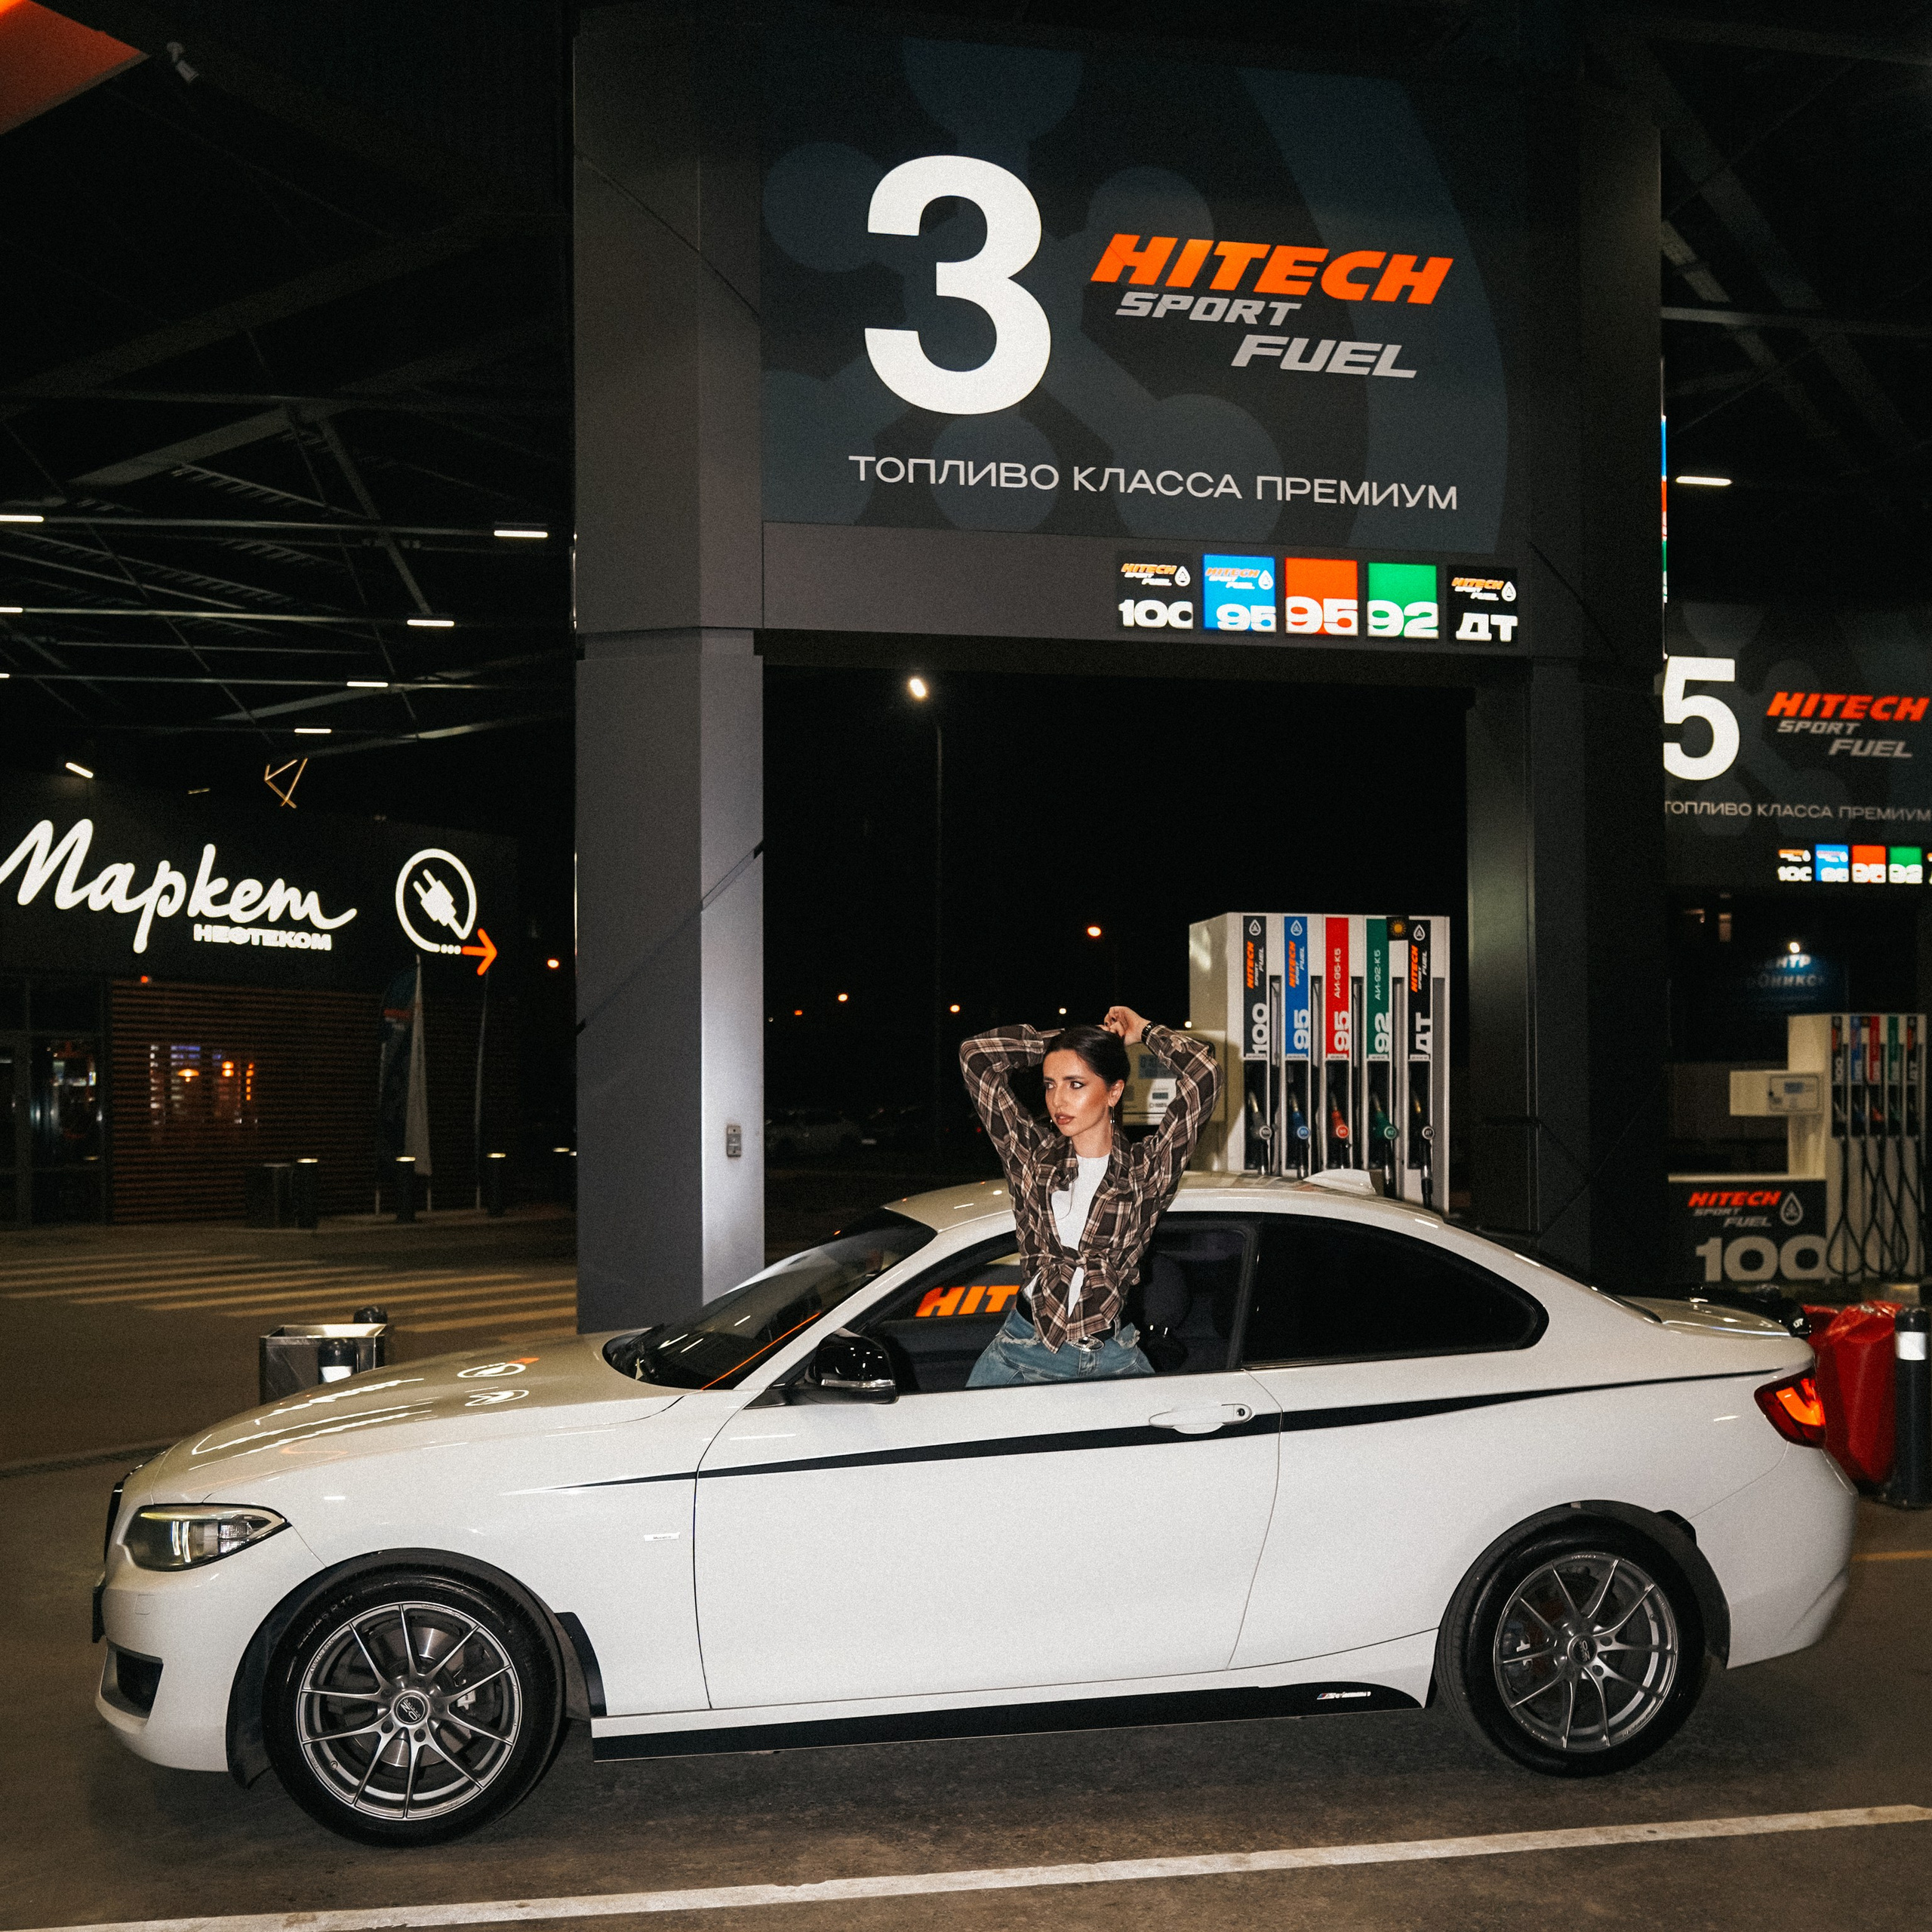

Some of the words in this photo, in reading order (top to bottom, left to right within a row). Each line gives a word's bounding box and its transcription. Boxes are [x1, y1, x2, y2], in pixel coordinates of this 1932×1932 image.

[865, 155, 1051, 415] 3
[1091, 233, 1454, 304] HITECH
[1115, 291, 1302, 326] SPORT
[1231, 334, 1417, 378] FUEL
[848, 455, 1060, 491] ТОПЛИВО
[1072, 466, 1243, 499] КЛАССА
[1257, 475, 1458, 510] ПРЕМИУМ
[1121, 563, 1177, 574] HITECH
[1204, 567, 1260, 577] HITECH
[1451, 577, 1504, 589] HITECH
[1118, 599, 1194, 629] 100
[1216, 603, 1277, 632] 95
[1285, 596, 1358, 635] 95
[1367, 600, 1439, 639] 92
[1455, 612, 1518, 642] ДТ
[1663, 656, 1740, 780] 5
[1766, 691, 1930, 721] HITECH
[1777, 719, 1860, 735] SPORT
[1828, 738, 1913, 758] FUEL
[1758, 803, 1834, 818] КЛАССА
[1839, 806, 1932, 822] ПРЕМИУМ
[0, 819, 358, 954] Маркет
[193, 924, 332, 951] НЕФТЕКОМ
[1411, 945, 1419, 993] HITECH
[1252, 1003, 1267, 1054] 100
[1294, 1009, 1309, 1050] 95
[1334, 1011, 1349, 1051] 95
[1374, 1012, 1390, 1054] 92
[1415, 1012, 1432, 1054] ДТ
[1696, 1234, 1829, 1282] 100
[400, 1701, 417, 1721] OZ
